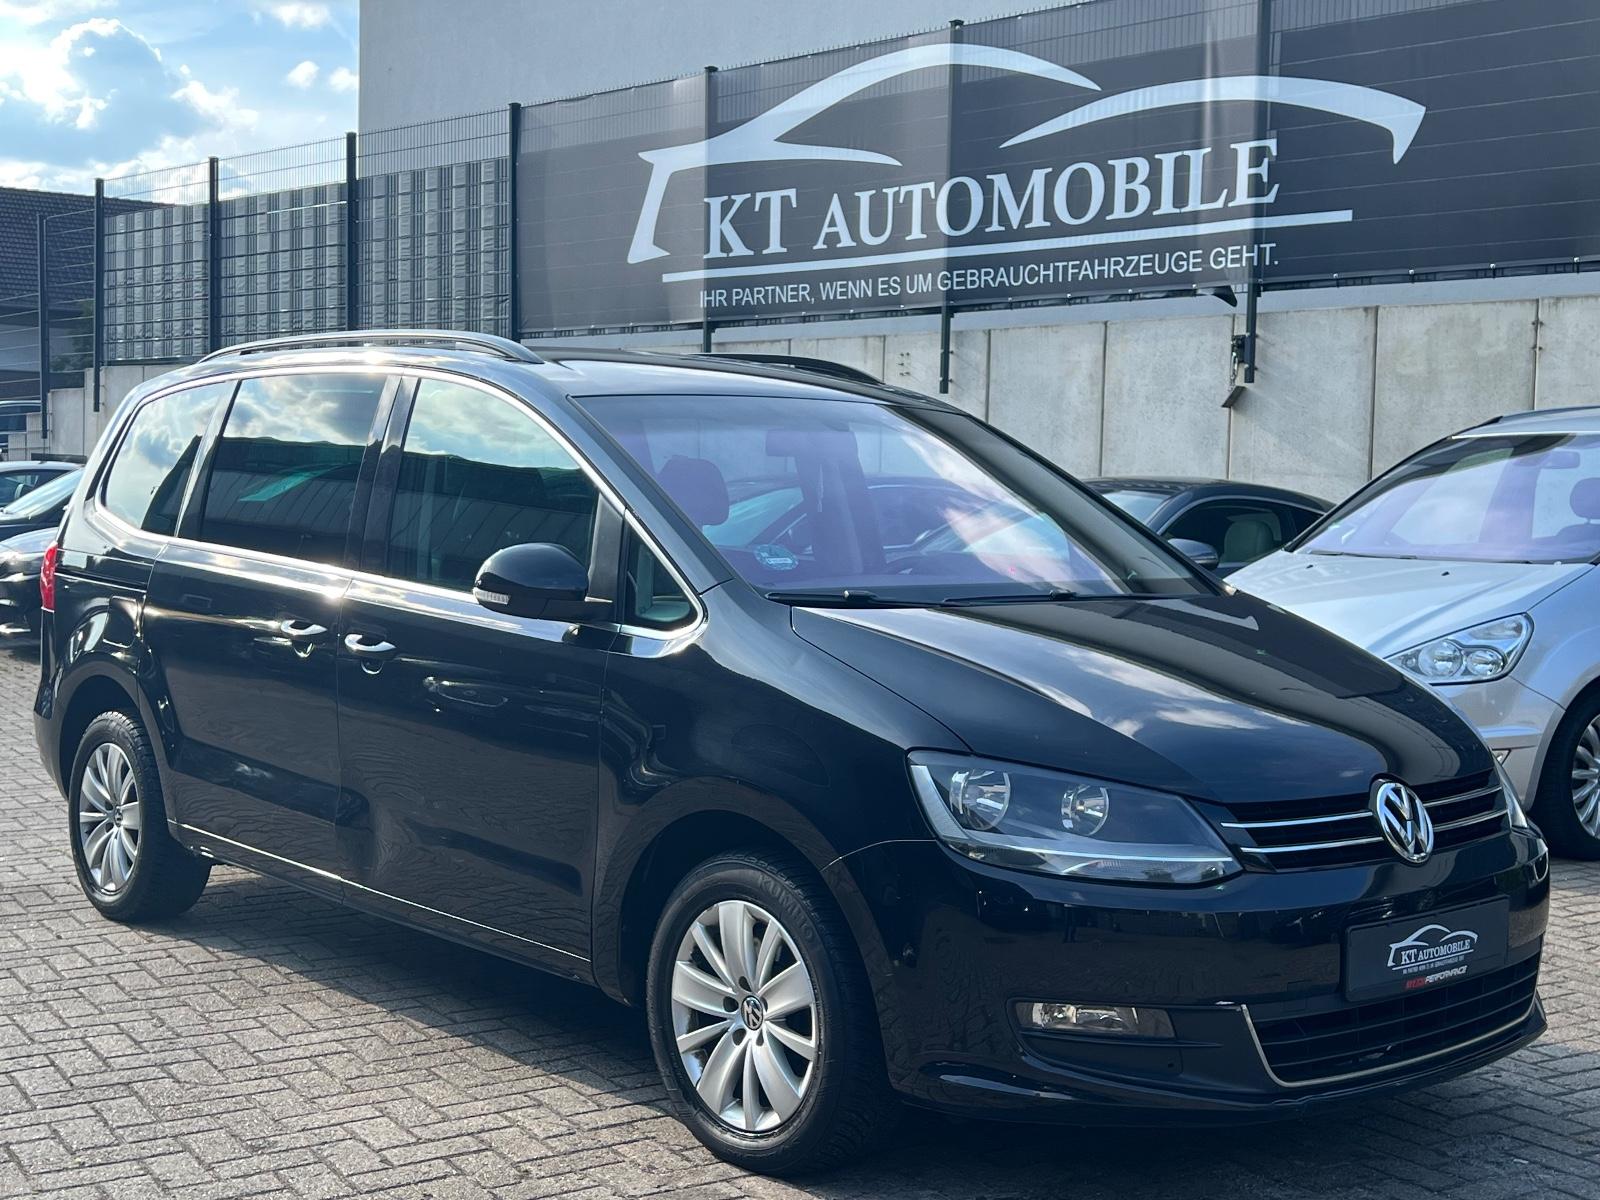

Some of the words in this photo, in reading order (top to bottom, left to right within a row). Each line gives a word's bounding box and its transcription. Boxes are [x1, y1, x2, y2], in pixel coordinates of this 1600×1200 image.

[703, 188, 797, 259] KT
[813, 138, 1281, 251] AUTOMOBILE
[699, 289, 727, 309] IHR
[733, 283, 815, 305] PARTNER,
[820, 279, 873, 300] WENN
[878, 276, 901, 297] ES
[906, 272, 932, 294] UM
[937, 250, 1203, 292] GEBRAUCHTFAHRZEUGE
[1209, 243, 1280, 270] GEHT.
[1400, 948, 1418, 965] KT
[1418, 938, 1471, 962] AUTOMOBILE
